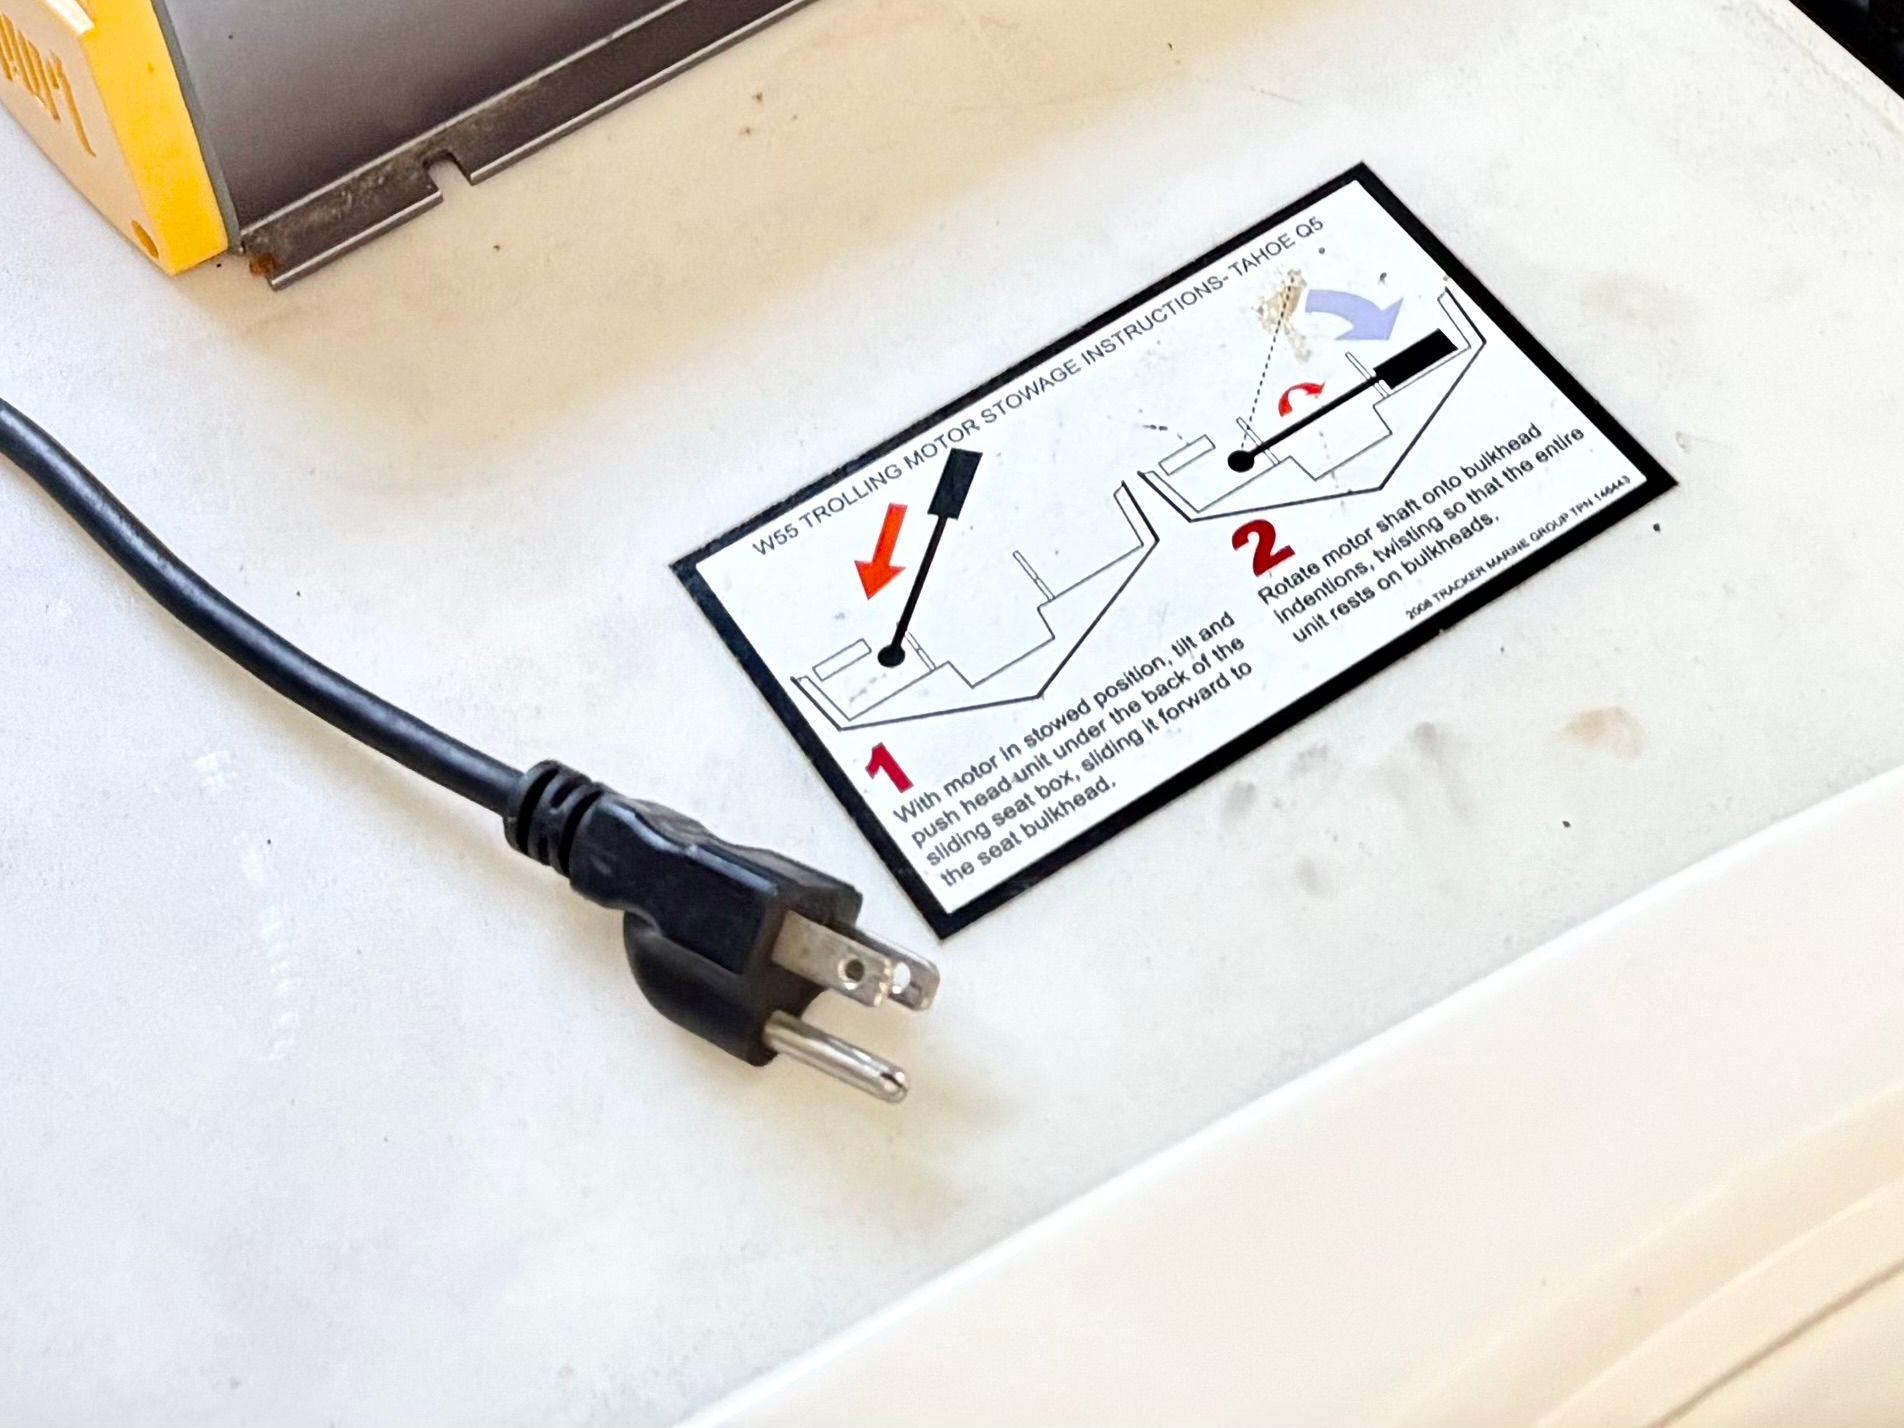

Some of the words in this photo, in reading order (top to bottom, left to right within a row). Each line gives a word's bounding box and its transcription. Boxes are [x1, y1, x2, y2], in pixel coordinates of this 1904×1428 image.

[753, 523, 798, 554] W55
[799, 464, 902, 527] TROLLING
[904, 419, 980, 469] MOTOR
[981, 359, 1081, 422] STOWAGE
[1228, 233, 1295, 275] TAHOE
[1296, 216, 1323, 237] Q5
[1233, 519, 1295, 576] 2
[1258, 563, 1320, 604] Rotate
[1322, 528, 1373, 566] motor
[1376, 499, 1422, 532] shaft
[1423, 476, 1462, 503] onto
[1461, 422, 1542, 478] bulkhead
[1274, 562, 1374, 623] indentions,
[1373, 516, 1444, 562] twisting
[1444, 502, 1466, 519] so
[1466, 476, 1504, 504] that
[1502, 460, 1534, 482] the
[1536, 429, 1584, 462] entire
[1293, 614, 1329, 642] unit
[1330, 587, 1375, 620] rests
[1378, 570, 1402, 589] on
[1401, 514, 1499, 574] bulkheads.
[1433, 566, 1486, 601] TRACKER
[1486, 538, 1530, 568] MARINE
[1530, 513, 1568, 540] GROUP
[1570, 498, 1594, 515] TPN
[866, 743, 913, 792] 1
[894, 792, 941, 822] With
[944, 755, 997, 796] motor
[1000, 744, 1021, 760] in
[1024, 698, 1091, 747] stowed
[1094, 656, 1172, 708] position,
[1172, 636, 1198, 657] tilt
[1199, 611, 1235, 641] and
[912, 811, 960, 848] push
[960, 776, 1012, 814] head
[1014, 753, 1052, 782] unit
[1053, 719, 1106, 759] under
[1109, 700, 1141, 724] the
[1142, 671, 1190, 704] back
[1193, 653, 1211, 674] of
[1212, 638, 1244, 661] the
[927, 822, 991, 865] sliding
[992, 793, 1036, 826] seat
[1035, 770, 1080, 799] box,
[1082, 729, 1144, 771] sliding
[1142, 718, 1159, 733] it
[1158, 672, 1230, 724] forward
[1231, 662, 1252, 679] to
[941, 862, 974, 886] the
[978, 831, 1022, 865] seat
[1020, 775, 1116, 838] bulkhead.
